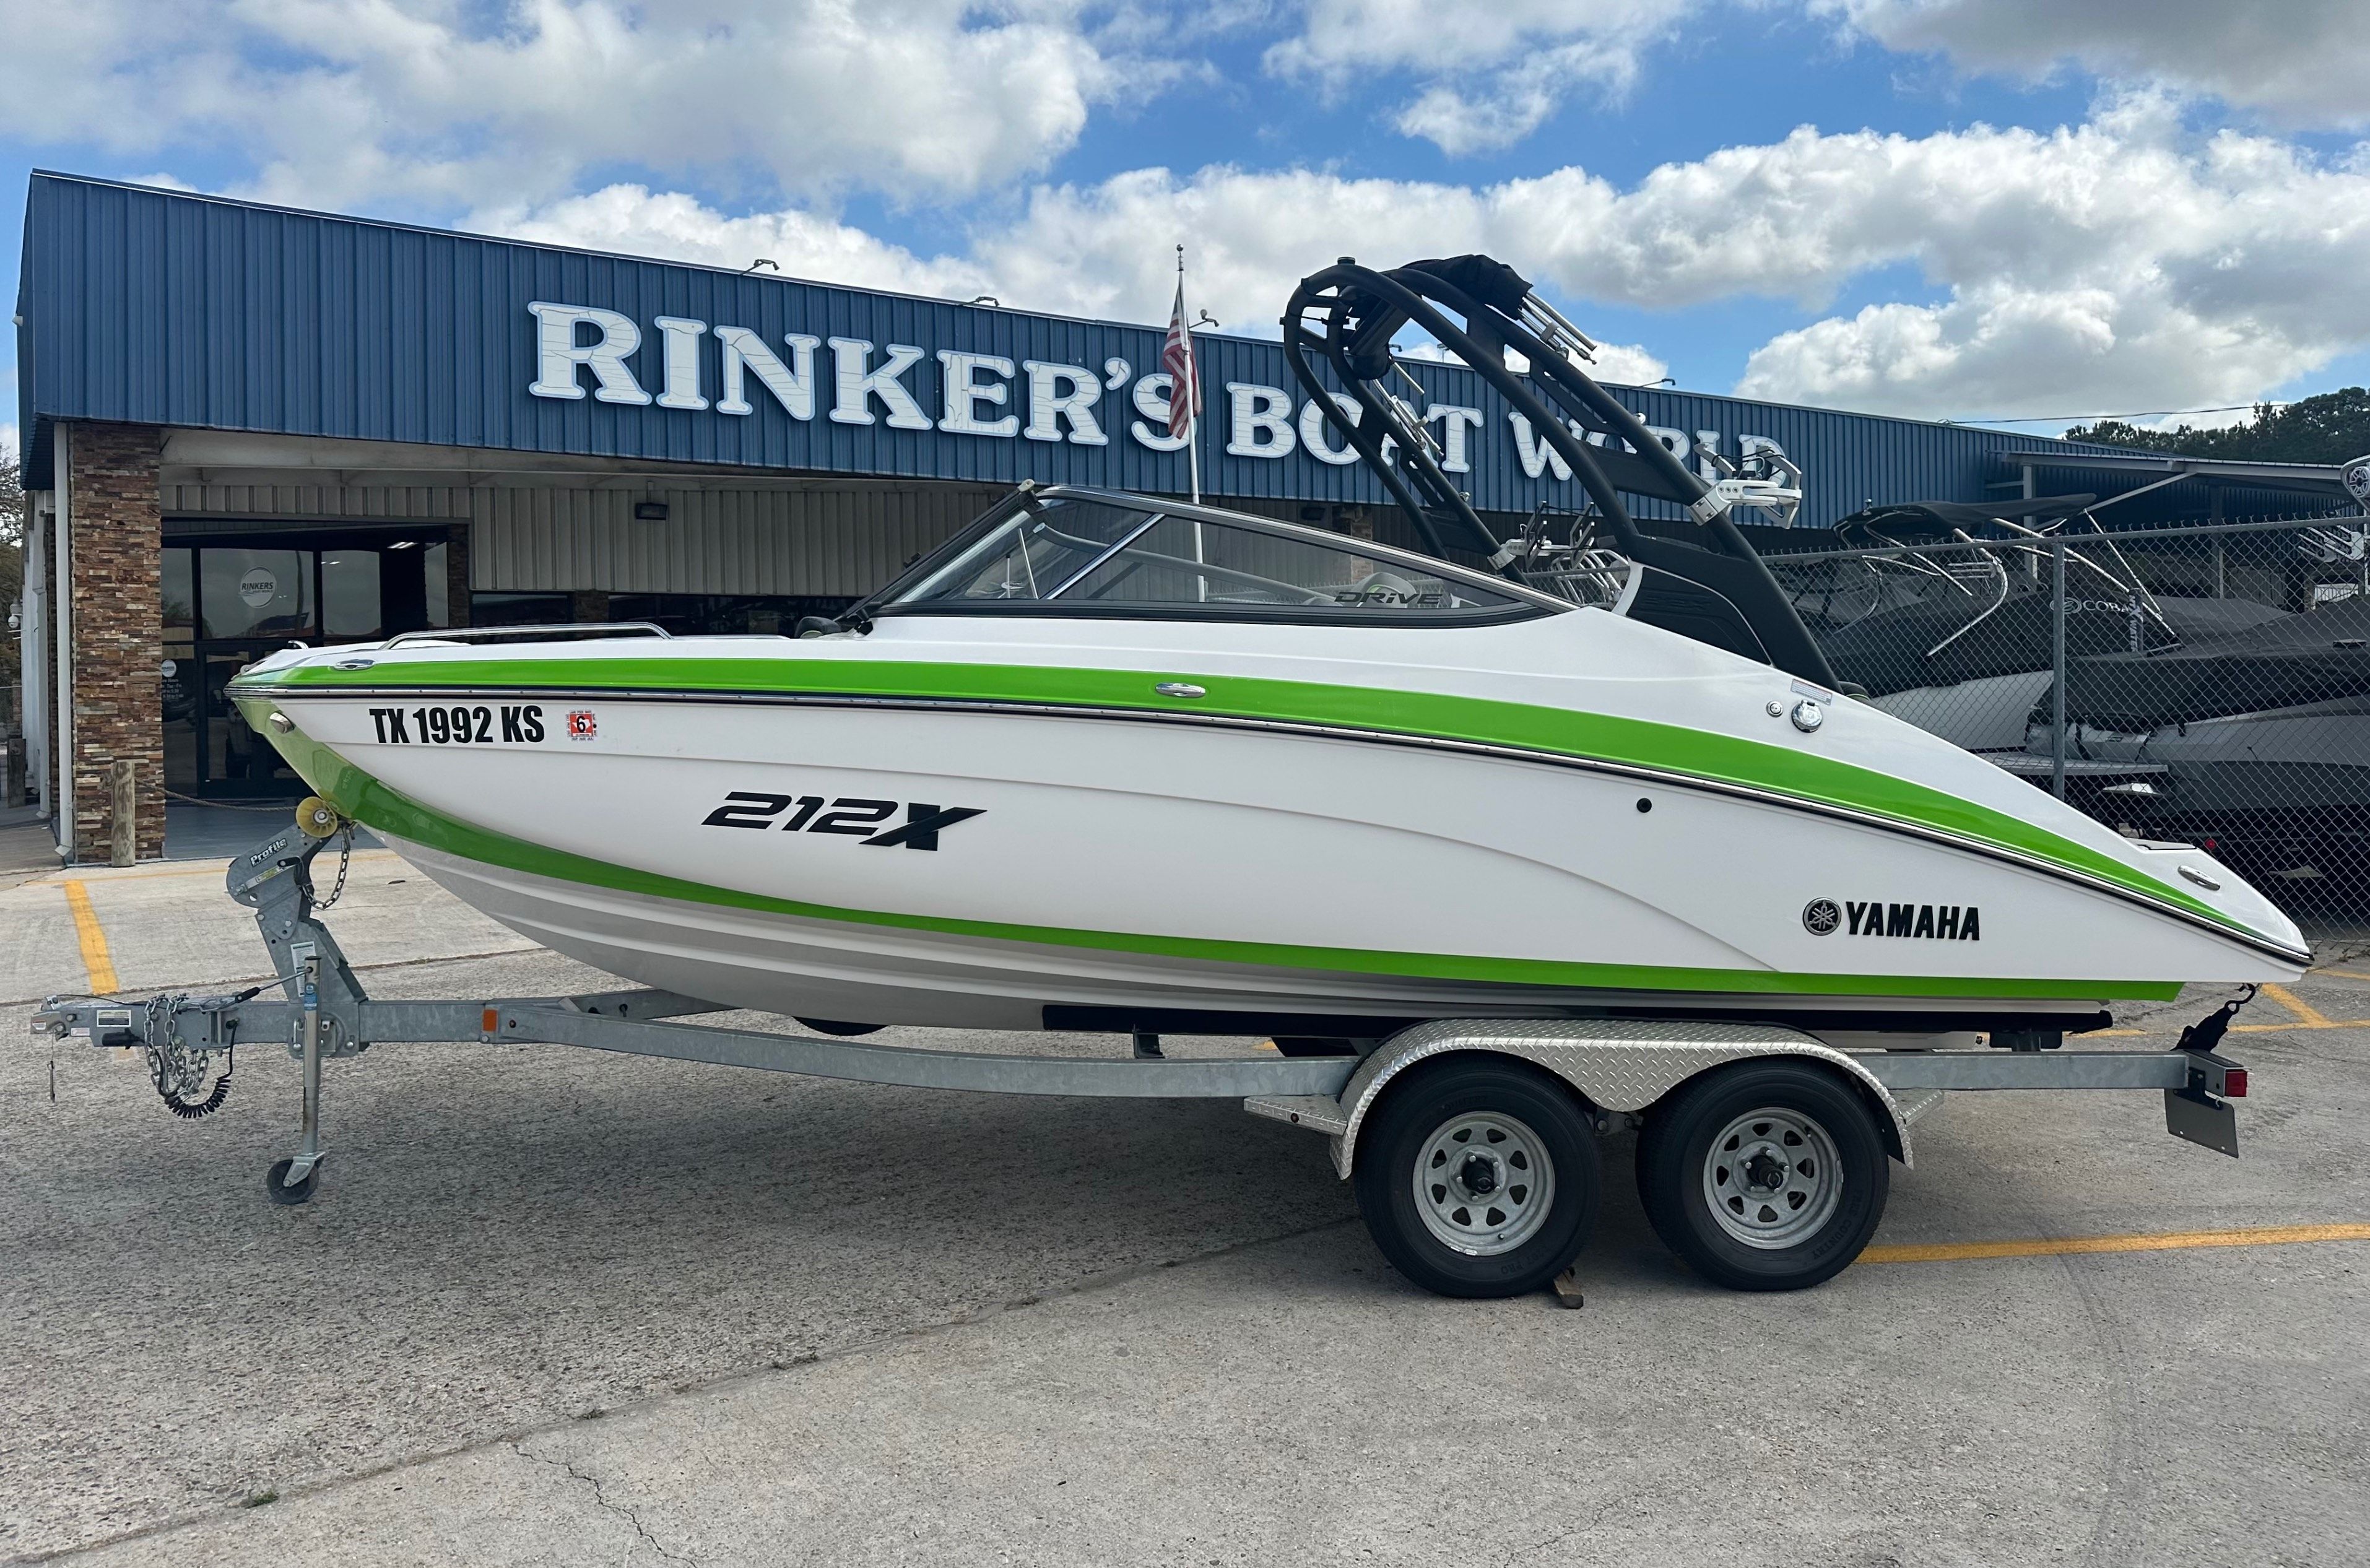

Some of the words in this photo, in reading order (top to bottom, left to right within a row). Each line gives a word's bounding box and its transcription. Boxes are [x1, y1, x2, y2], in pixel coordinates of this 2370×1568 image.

[528, 301, 1197, 452] RINKER'S
[1508, 412, 1788, 490] WLD
[241, 582, 274, 590] RINKERS
[2083, 600, 2130, 613] COBA
[369, 708, 410, 743] TX
[412, 707, 493, 744] 1992
[501, 705, 545, 743] KS
[576, 716, 586, 733] 6
[701, 790, 988, 852] 212X
[250, 838, 287, 867] Profile
[1846, 901, 1980, 940] YAMAHA
